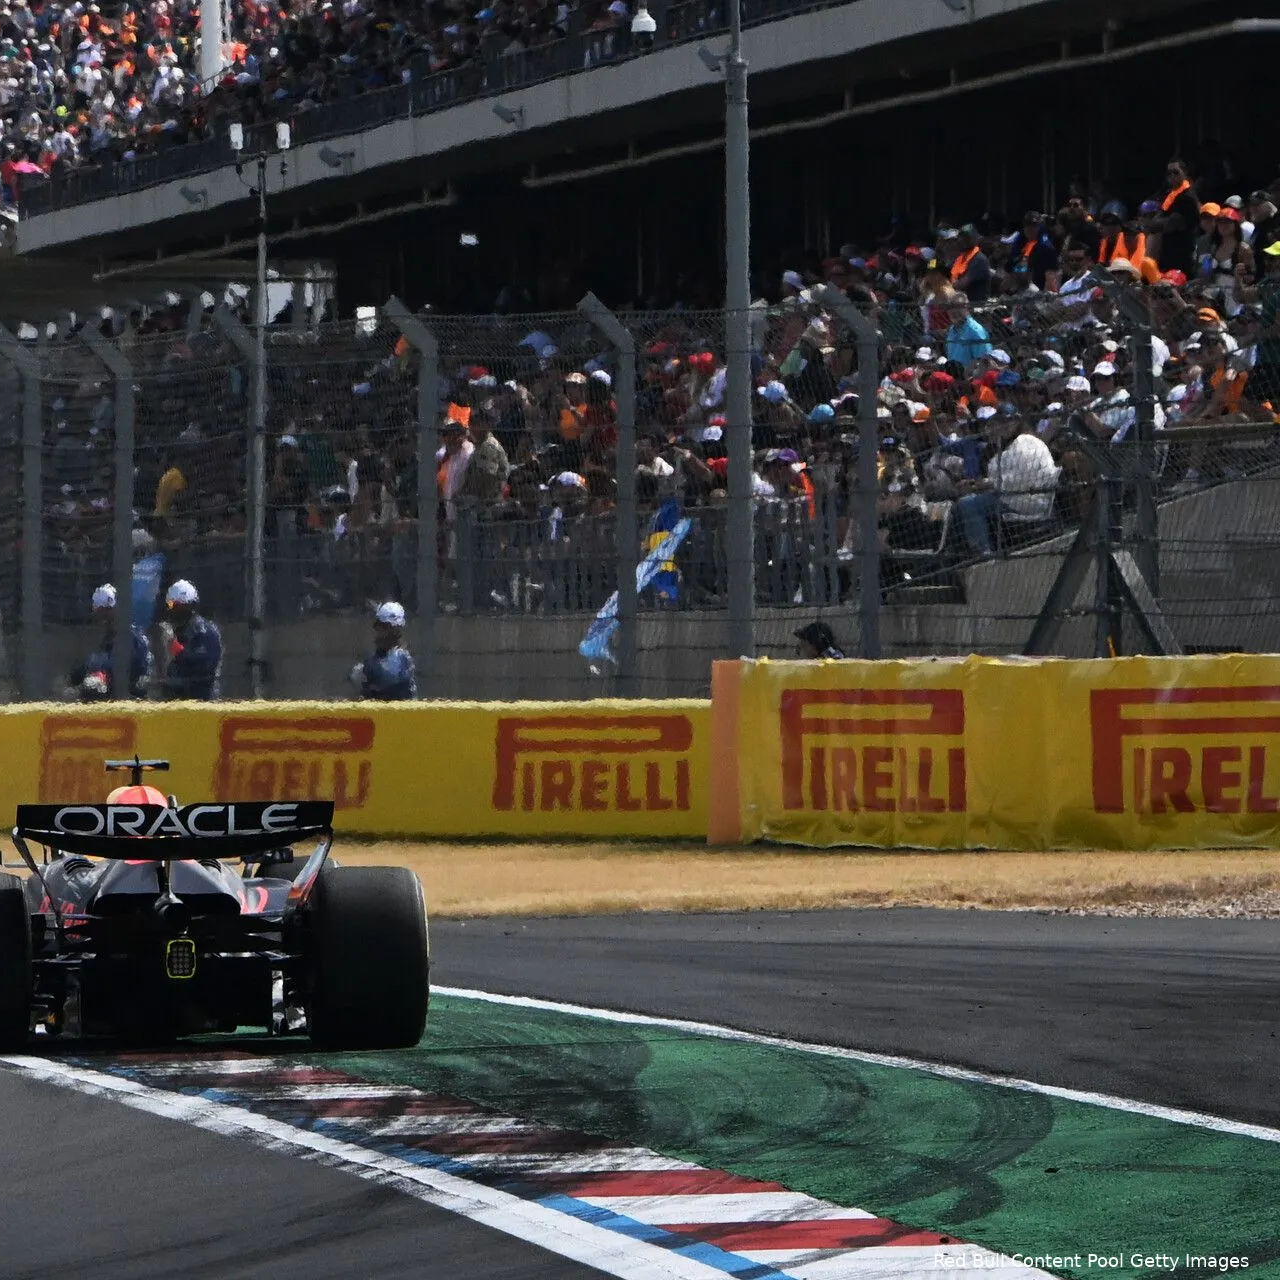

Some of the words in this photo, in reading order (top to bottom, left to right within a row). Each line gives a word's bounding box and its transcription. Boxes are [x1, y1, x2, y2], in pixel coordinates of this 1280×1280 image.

[492, 715, 693, 812] PIRELLI
[780, 689, 968, 813] PIRELLI
[1091, 686, 1280, 814] PIREL
[54, 804, 299, 837] ORACLE
